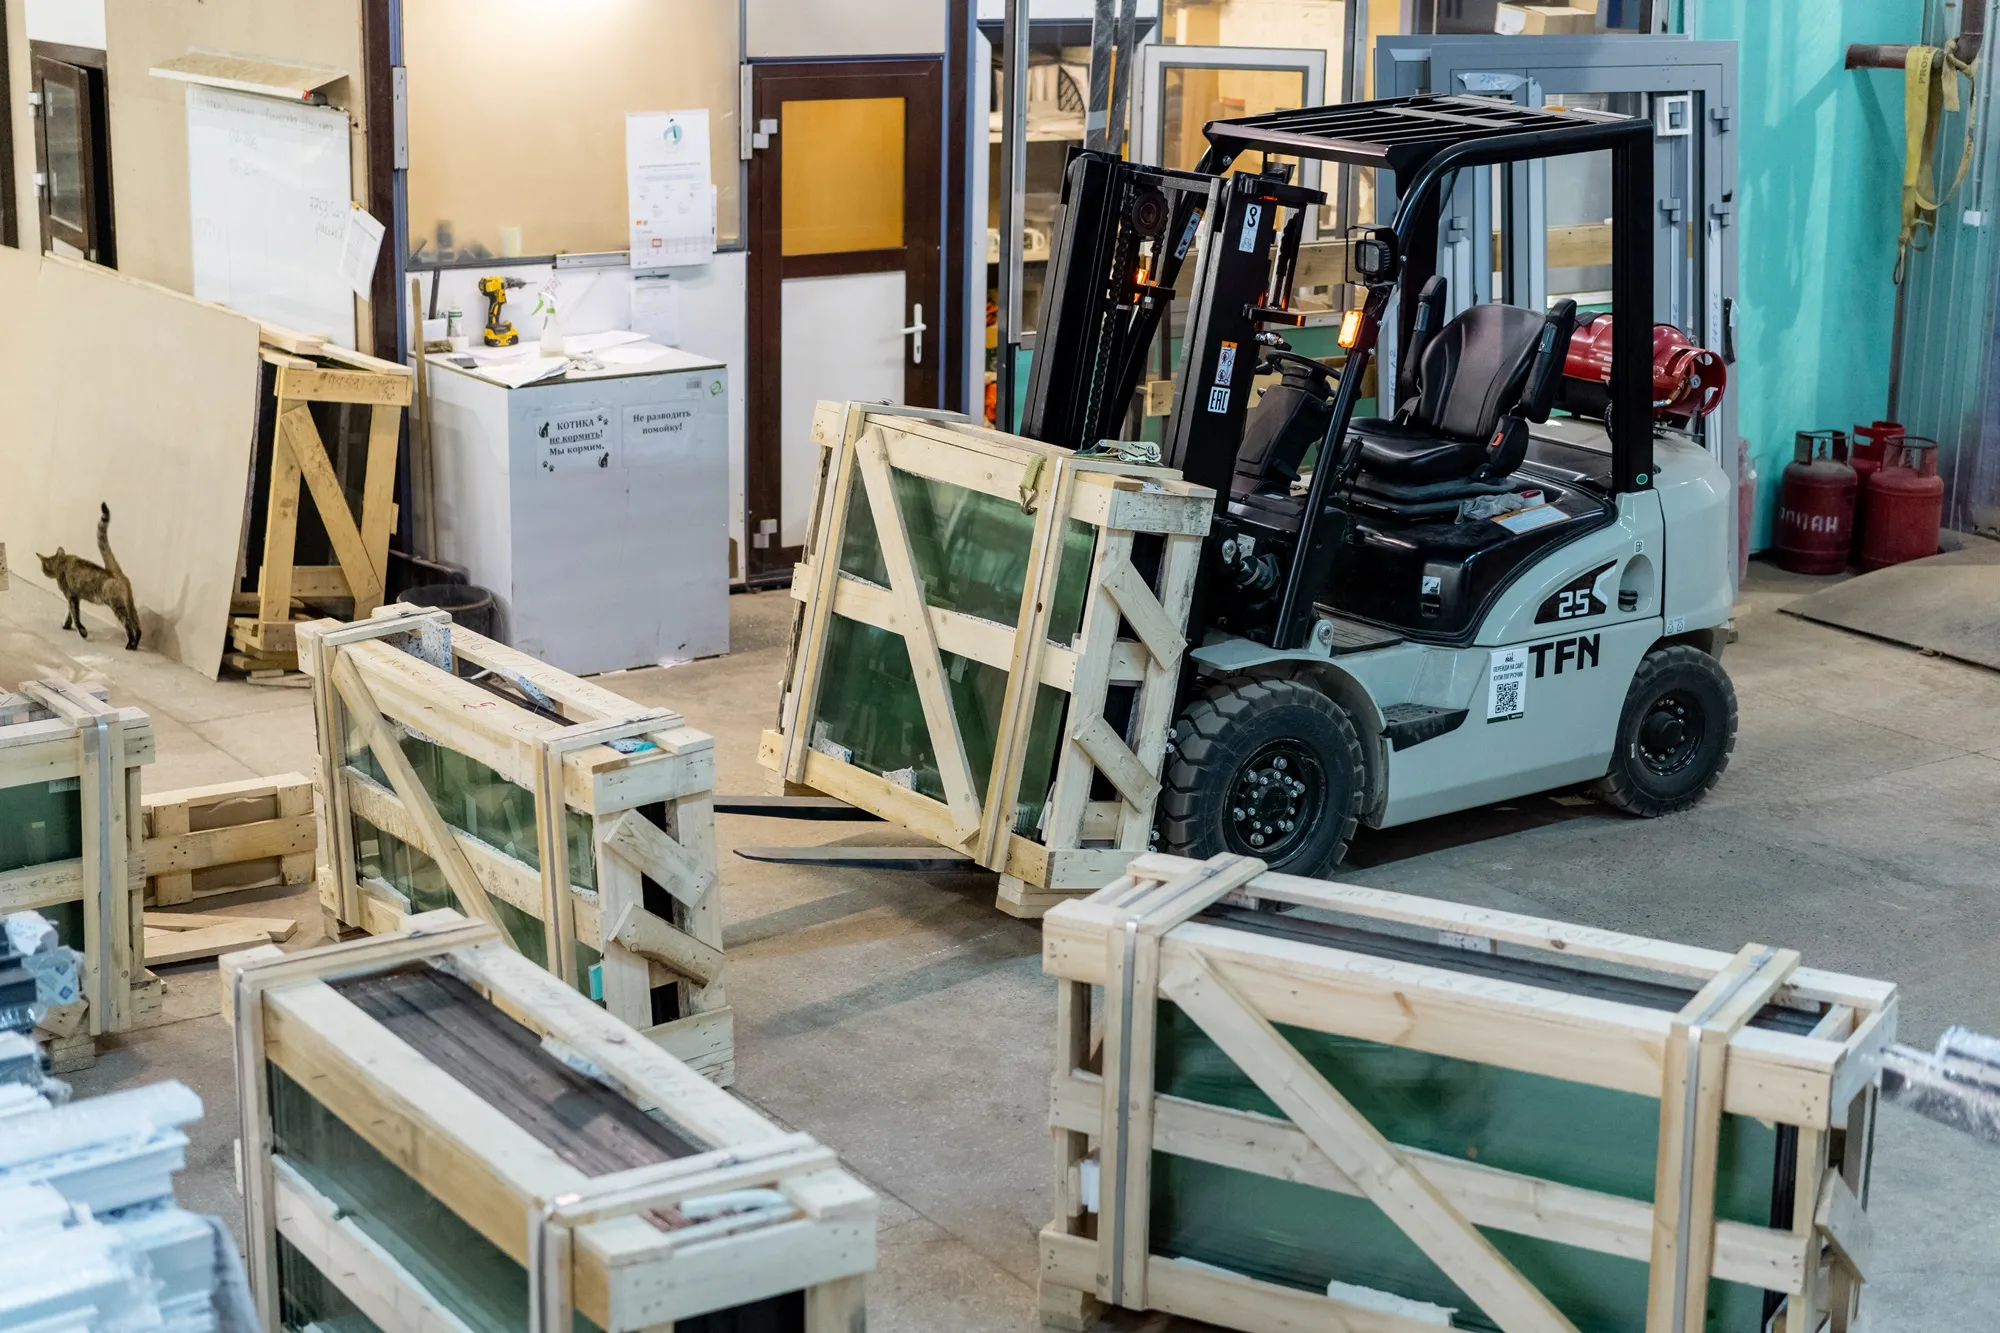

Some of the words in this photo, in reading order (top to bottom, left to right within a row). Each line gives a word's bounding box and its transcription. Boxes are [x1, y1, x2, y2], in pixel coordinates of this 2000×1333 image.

[633, 413, 644, 423] Не
[646, 410, 691, 424] разводить
[557, 418, 594, 431] КОТИКА
[642, 422, 683, 436] помойку!
[549, 436, 561, 445] не
[562, 429, 604, 445] кормить!
[549, 447, 565, 456] Мы
[567, 442, 605, 455] кормим.
[1558, 588, 1590, 619] 25
[1528, 633, 1600, 679] TFN
